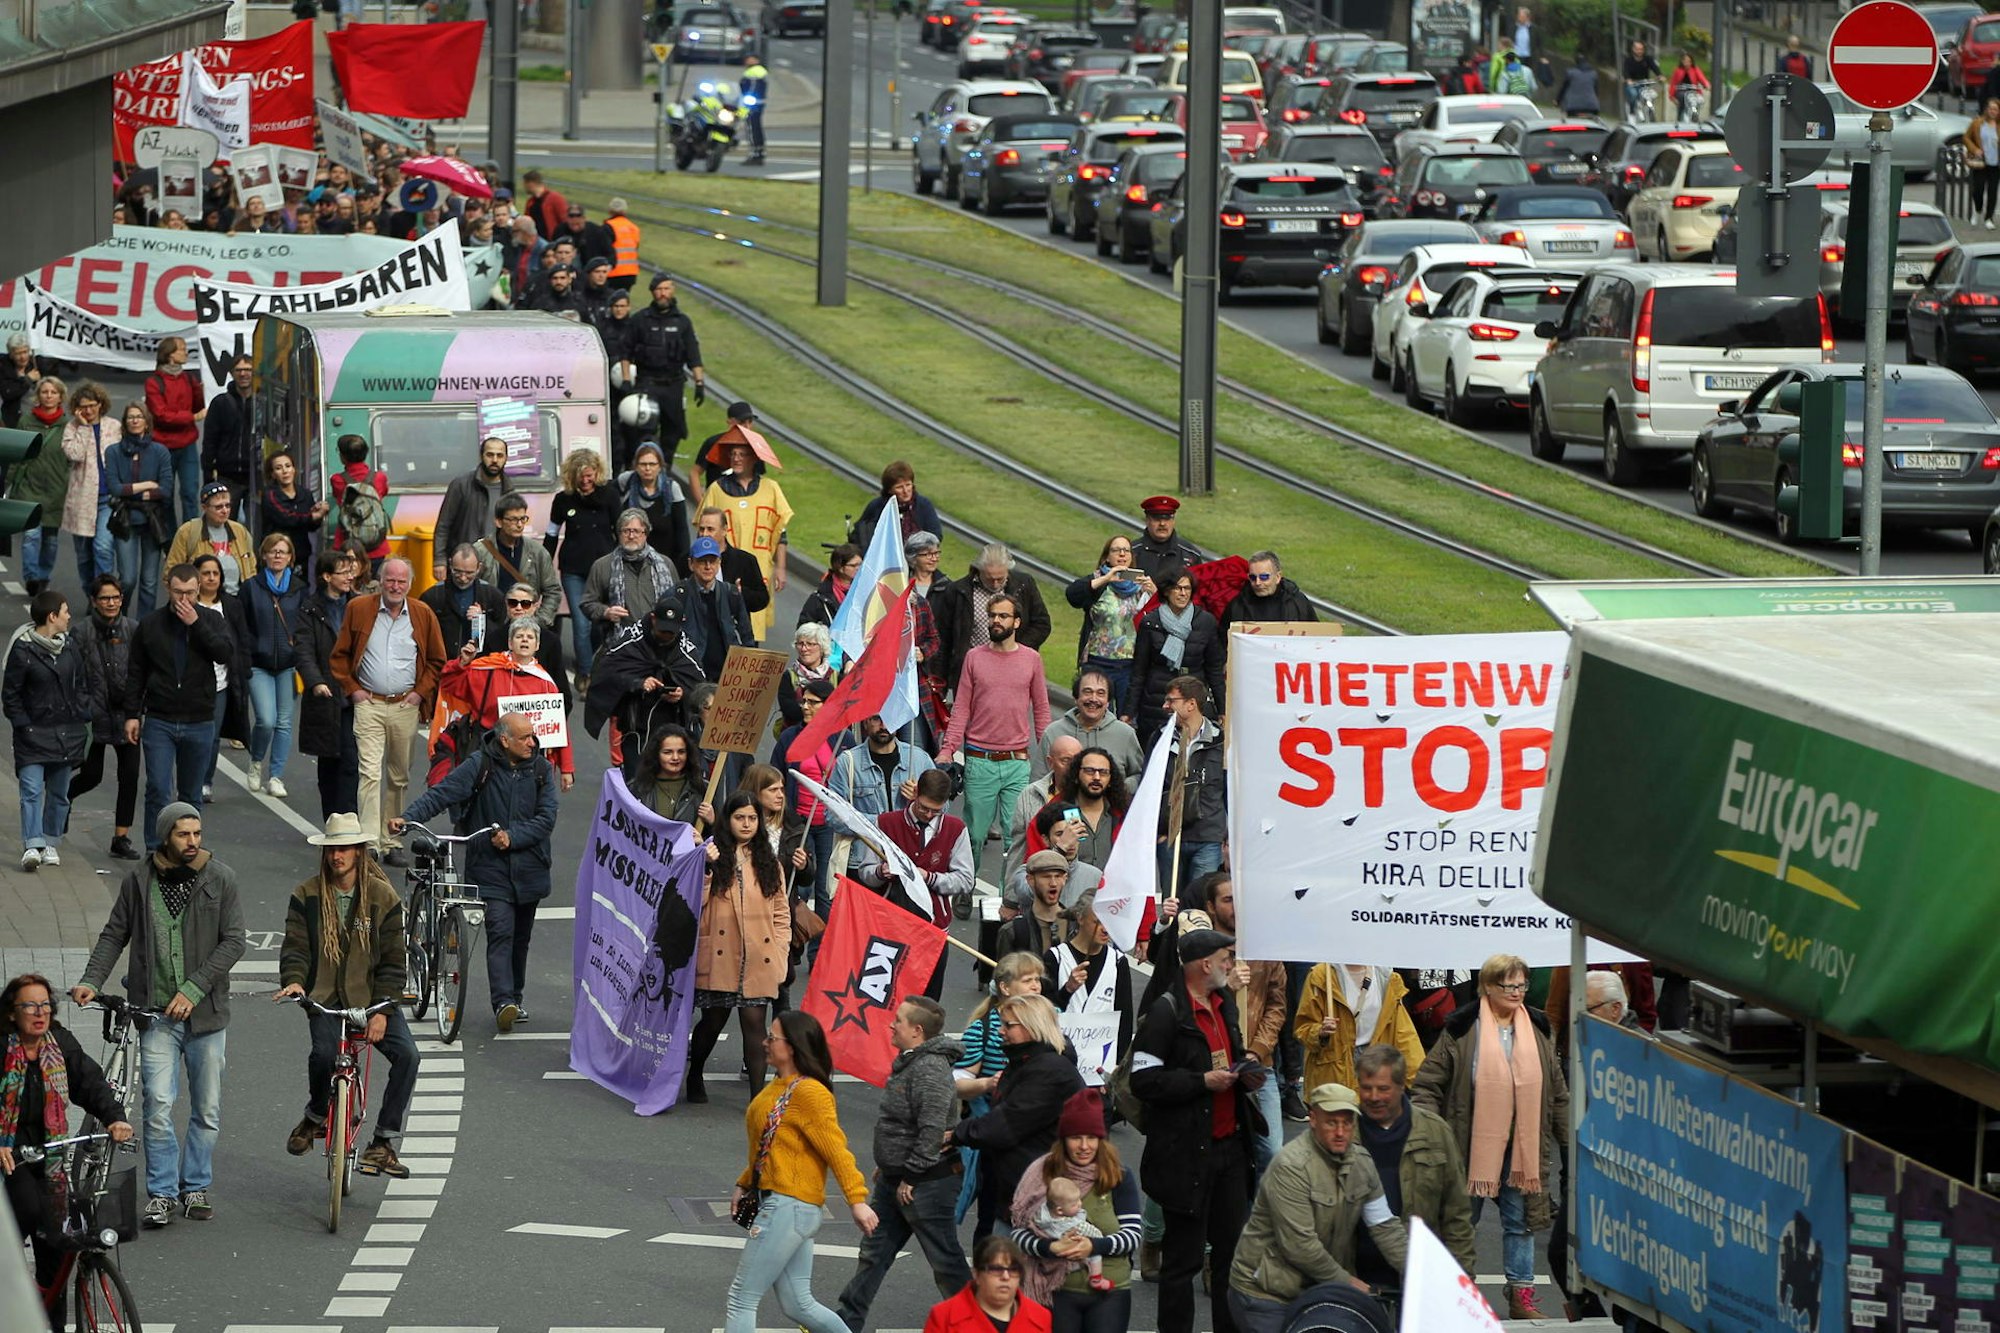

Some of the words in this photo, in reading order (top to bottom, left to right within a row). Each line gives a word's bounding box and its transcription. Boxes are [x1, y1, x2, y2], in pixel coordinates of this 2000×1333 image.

[220, 247, 248, 260] LEG
[252, 246, 263, 258] &
[362, 375, 565, 391] WWW.WOHNEN-WAGEN.DE
[1772, 600, 1956, 613] Europcar
[727, 655, 747, 671] WIR
[722, 674, 742, 688] WO
[749, 678, 771, 690] WIR
[1275, 661, 1553, 707] MIETENW
[501, 699, 563, 712] WOHNUNGSLOS
[714, 706, 759, 728] MIETEN
[1278, 725, 1554, 812] STOP
[1385, 830, 1456, 851] STOP
[1362, 862, 1425, 887] KIRA
[1351, 910, 1548, 929] SOLIDARITÄTSNETZWERK
[1701, 894, 1769, 959] moving
[1810, 938, 1855, 995] way
[1590, 1048, 1649, 1121] Gegen
[1652, 1074, 1813, 1207] Mietenwahnsinn,
[1589, 1123, 1726, 1249] Luxussanierung
[1729, 1200, 1768, 1256] und
[1589, 1194, 1708, 1313] Verdrängung!
